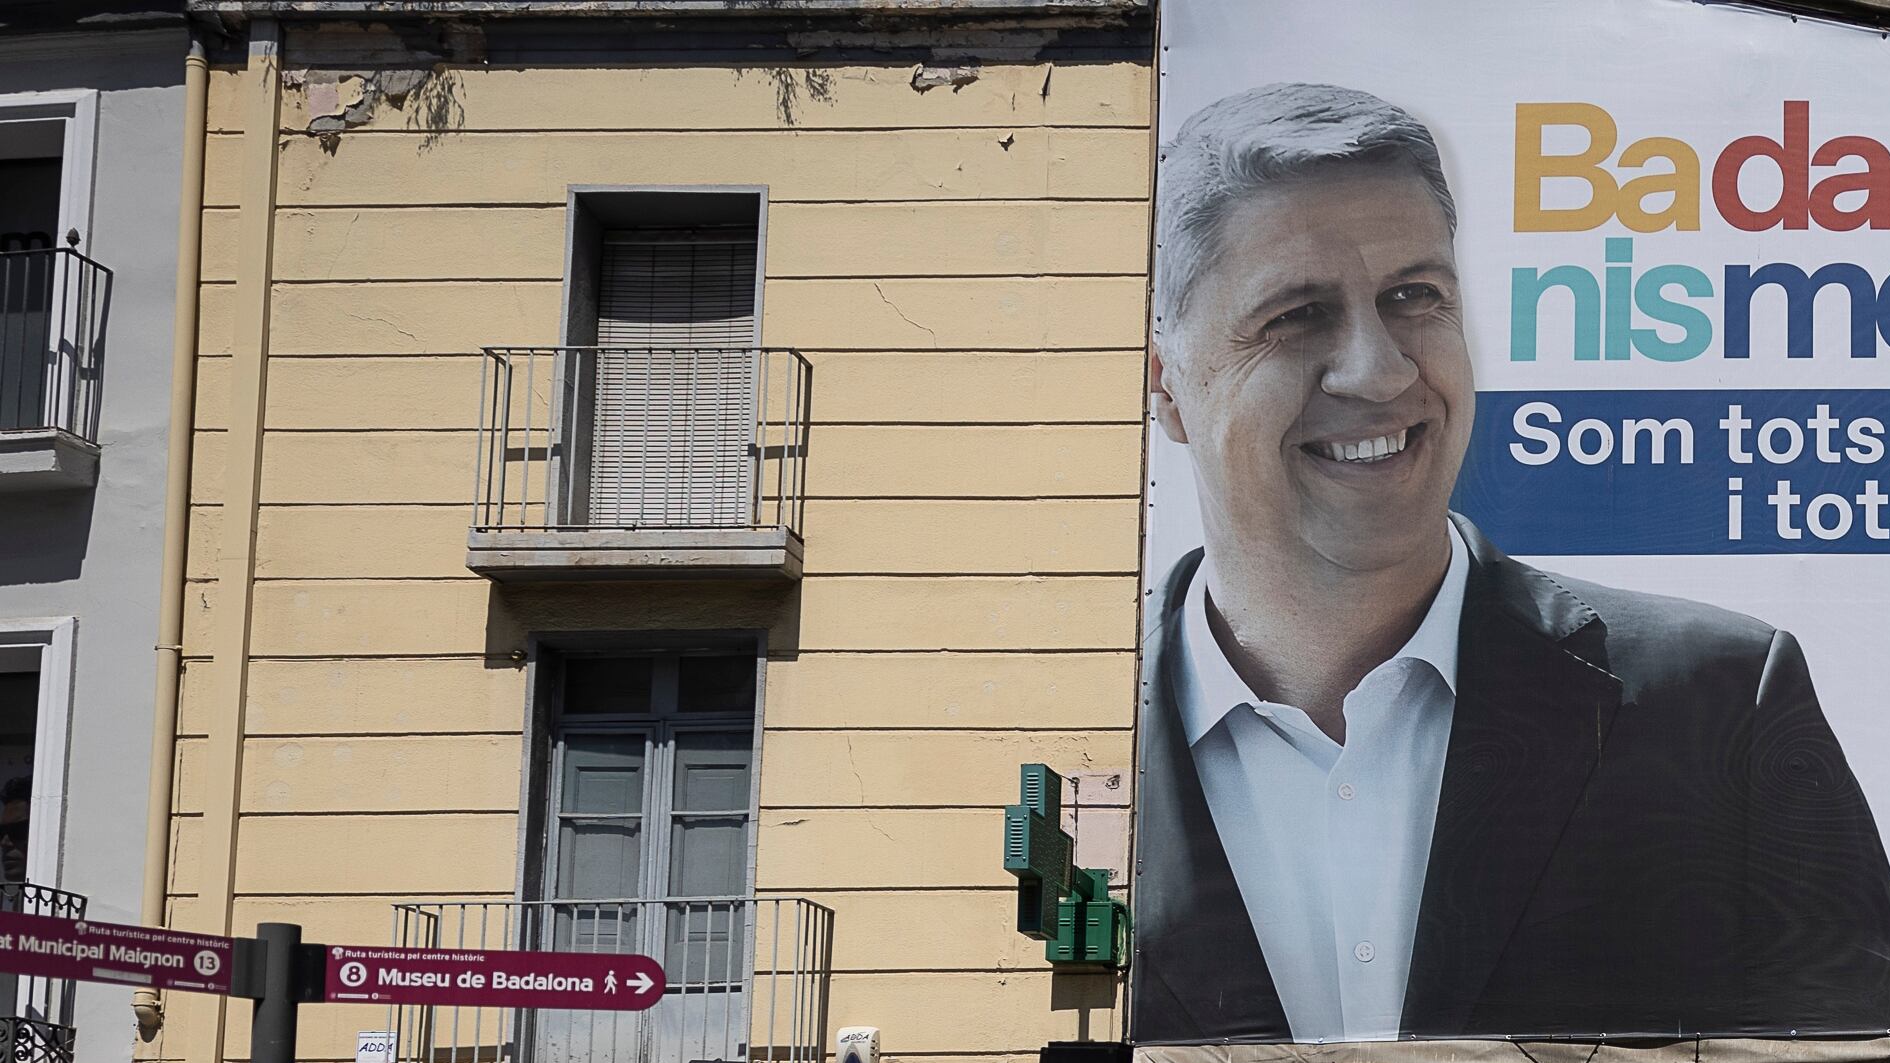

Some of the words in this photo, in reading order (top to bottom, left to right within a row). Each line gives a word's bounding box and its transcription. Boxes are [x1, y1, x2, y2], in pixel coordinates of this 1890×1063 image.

[1509, 401, 1694, 465] Som
[1719, 404, 1885, 464] tots
[1728, 477, 1742, 540] i
[19, 935, 104, 961] Municipal
[109, 945, 184, 968] Maignon
[198, 955, 216, 970] 13
[89, 926, 111, 937] Ruta
[113, 929, 150, 942] turística
[152, 934, 165, 943] pel
[167, 936, 195, 946] centre
[197, 937, 230, 949] històric
[345, 950, 366, 958] Ruta
[368, 950, 405, 959] turística
[407, 953, 420, 961] pel
[452, 953, 485, 962] històric
[346, 966, 361, 983] 8
[378, 968, 450, 987] Museu
[456, 971, 485, 989] de
[492, 971, 594, 992] Badalona
